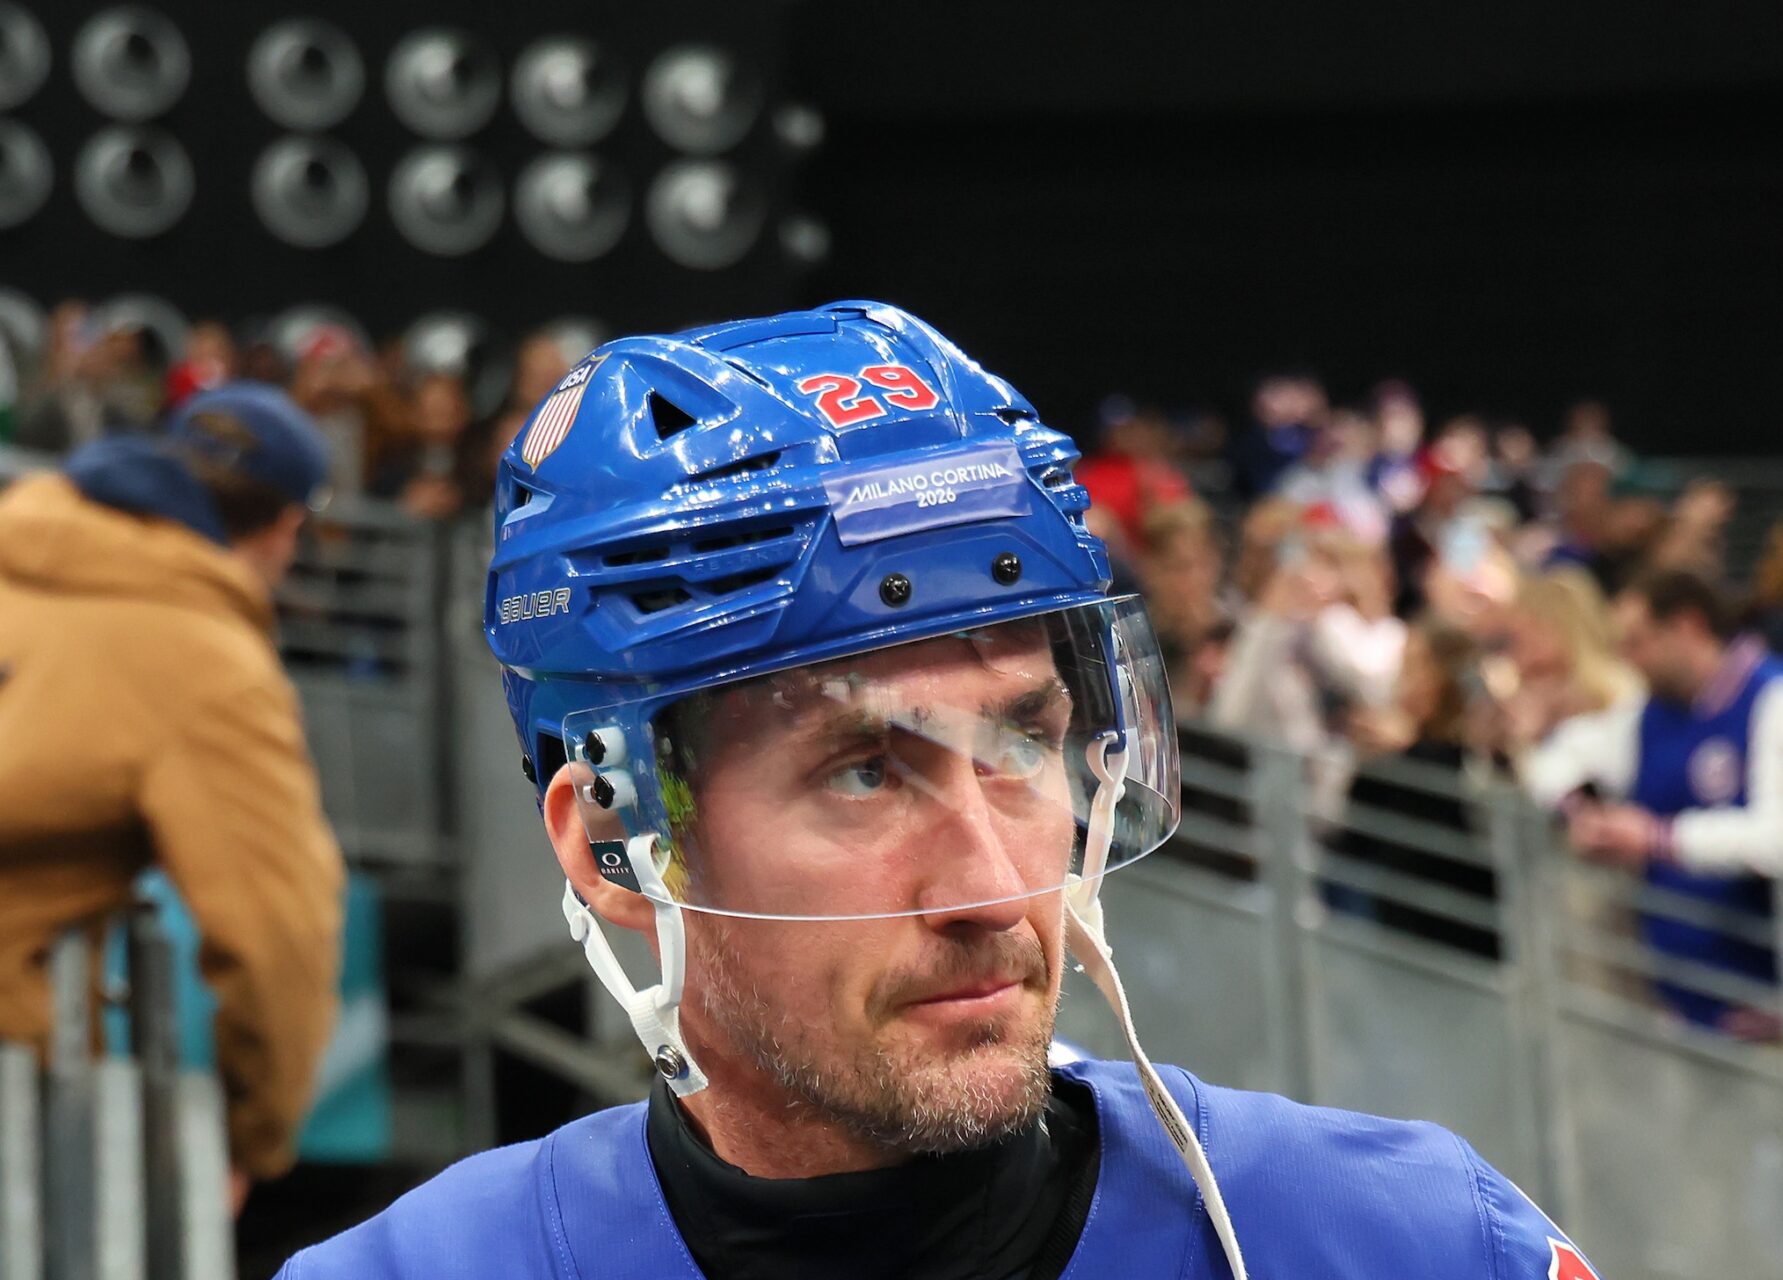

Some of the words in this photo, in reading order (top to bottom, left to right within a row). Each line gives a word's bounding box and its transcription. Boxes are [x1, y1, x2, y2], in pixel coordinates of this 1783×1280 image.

[559, 364, 592, 391] USA
[797, 365, 940, 429] 29
[845, 474, 930, 505] MILANO
[930, 463, 1014, 487] CORTINA
[916, 488, 956, 508] 2026
[500, 587, 571, 625] BAUER
